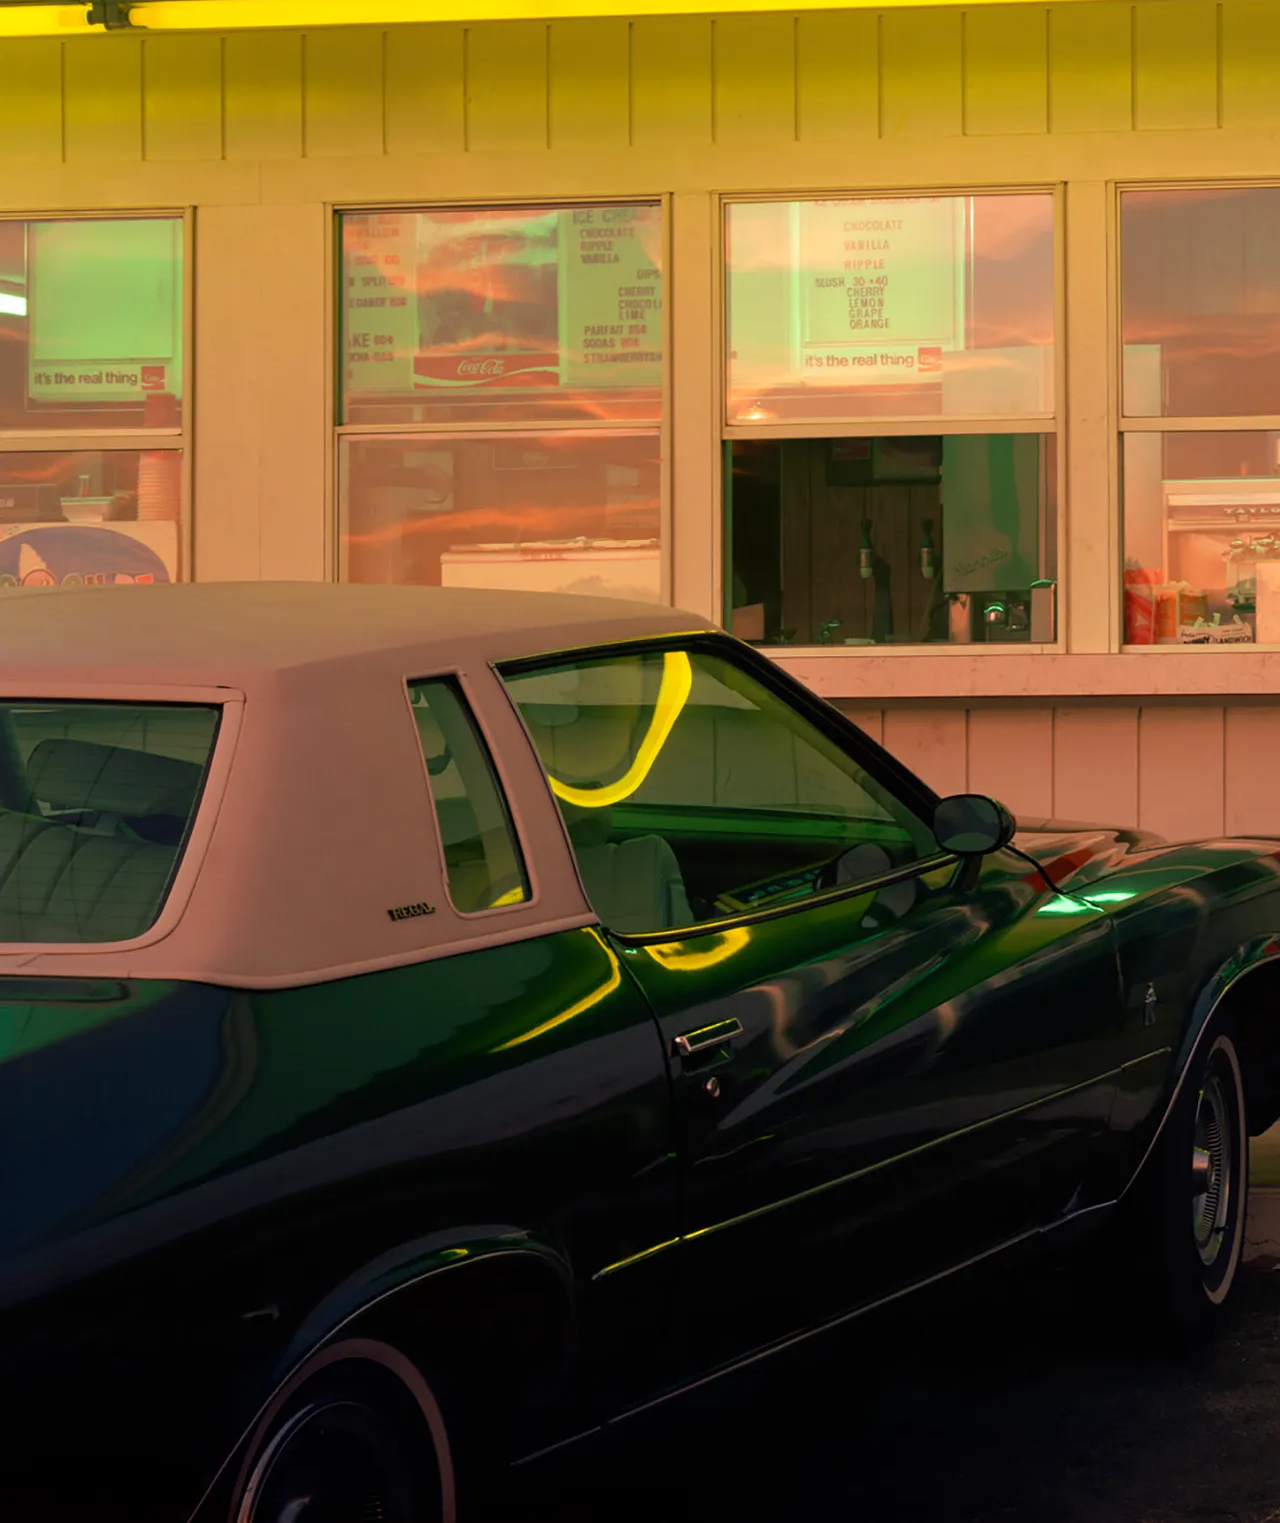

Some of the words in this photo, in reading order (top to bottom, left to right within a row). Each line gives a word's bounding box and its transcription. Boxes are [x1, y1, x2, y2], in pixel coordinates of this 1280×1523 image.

[843, 220, 903, 232] CHOCOLATE
[844, 239, 890, 251] VANILLA
[844, 258, 885, 271] RIPPLE
[815, 277, 845, 288] SLUSH
[847, 286, 885, 297] CHERRY
[848, 297, 884, 309] LEMON
[848, 308, 883, 319] GRAPE
[849, 318, 890, 330] ORANGE
[805, 354, 823, 367] it's
[826, 354, 849, 367] the
[851, 354, 877, 366] real
[880, 353, 914, 369] thing
[34, 372, 52, 385] it's
[54, 372, 76, 385] the
[78, 372, 103, 385] real
[105, 372, 138, 386] thing
[387, 902, 436, 922] REGAL
